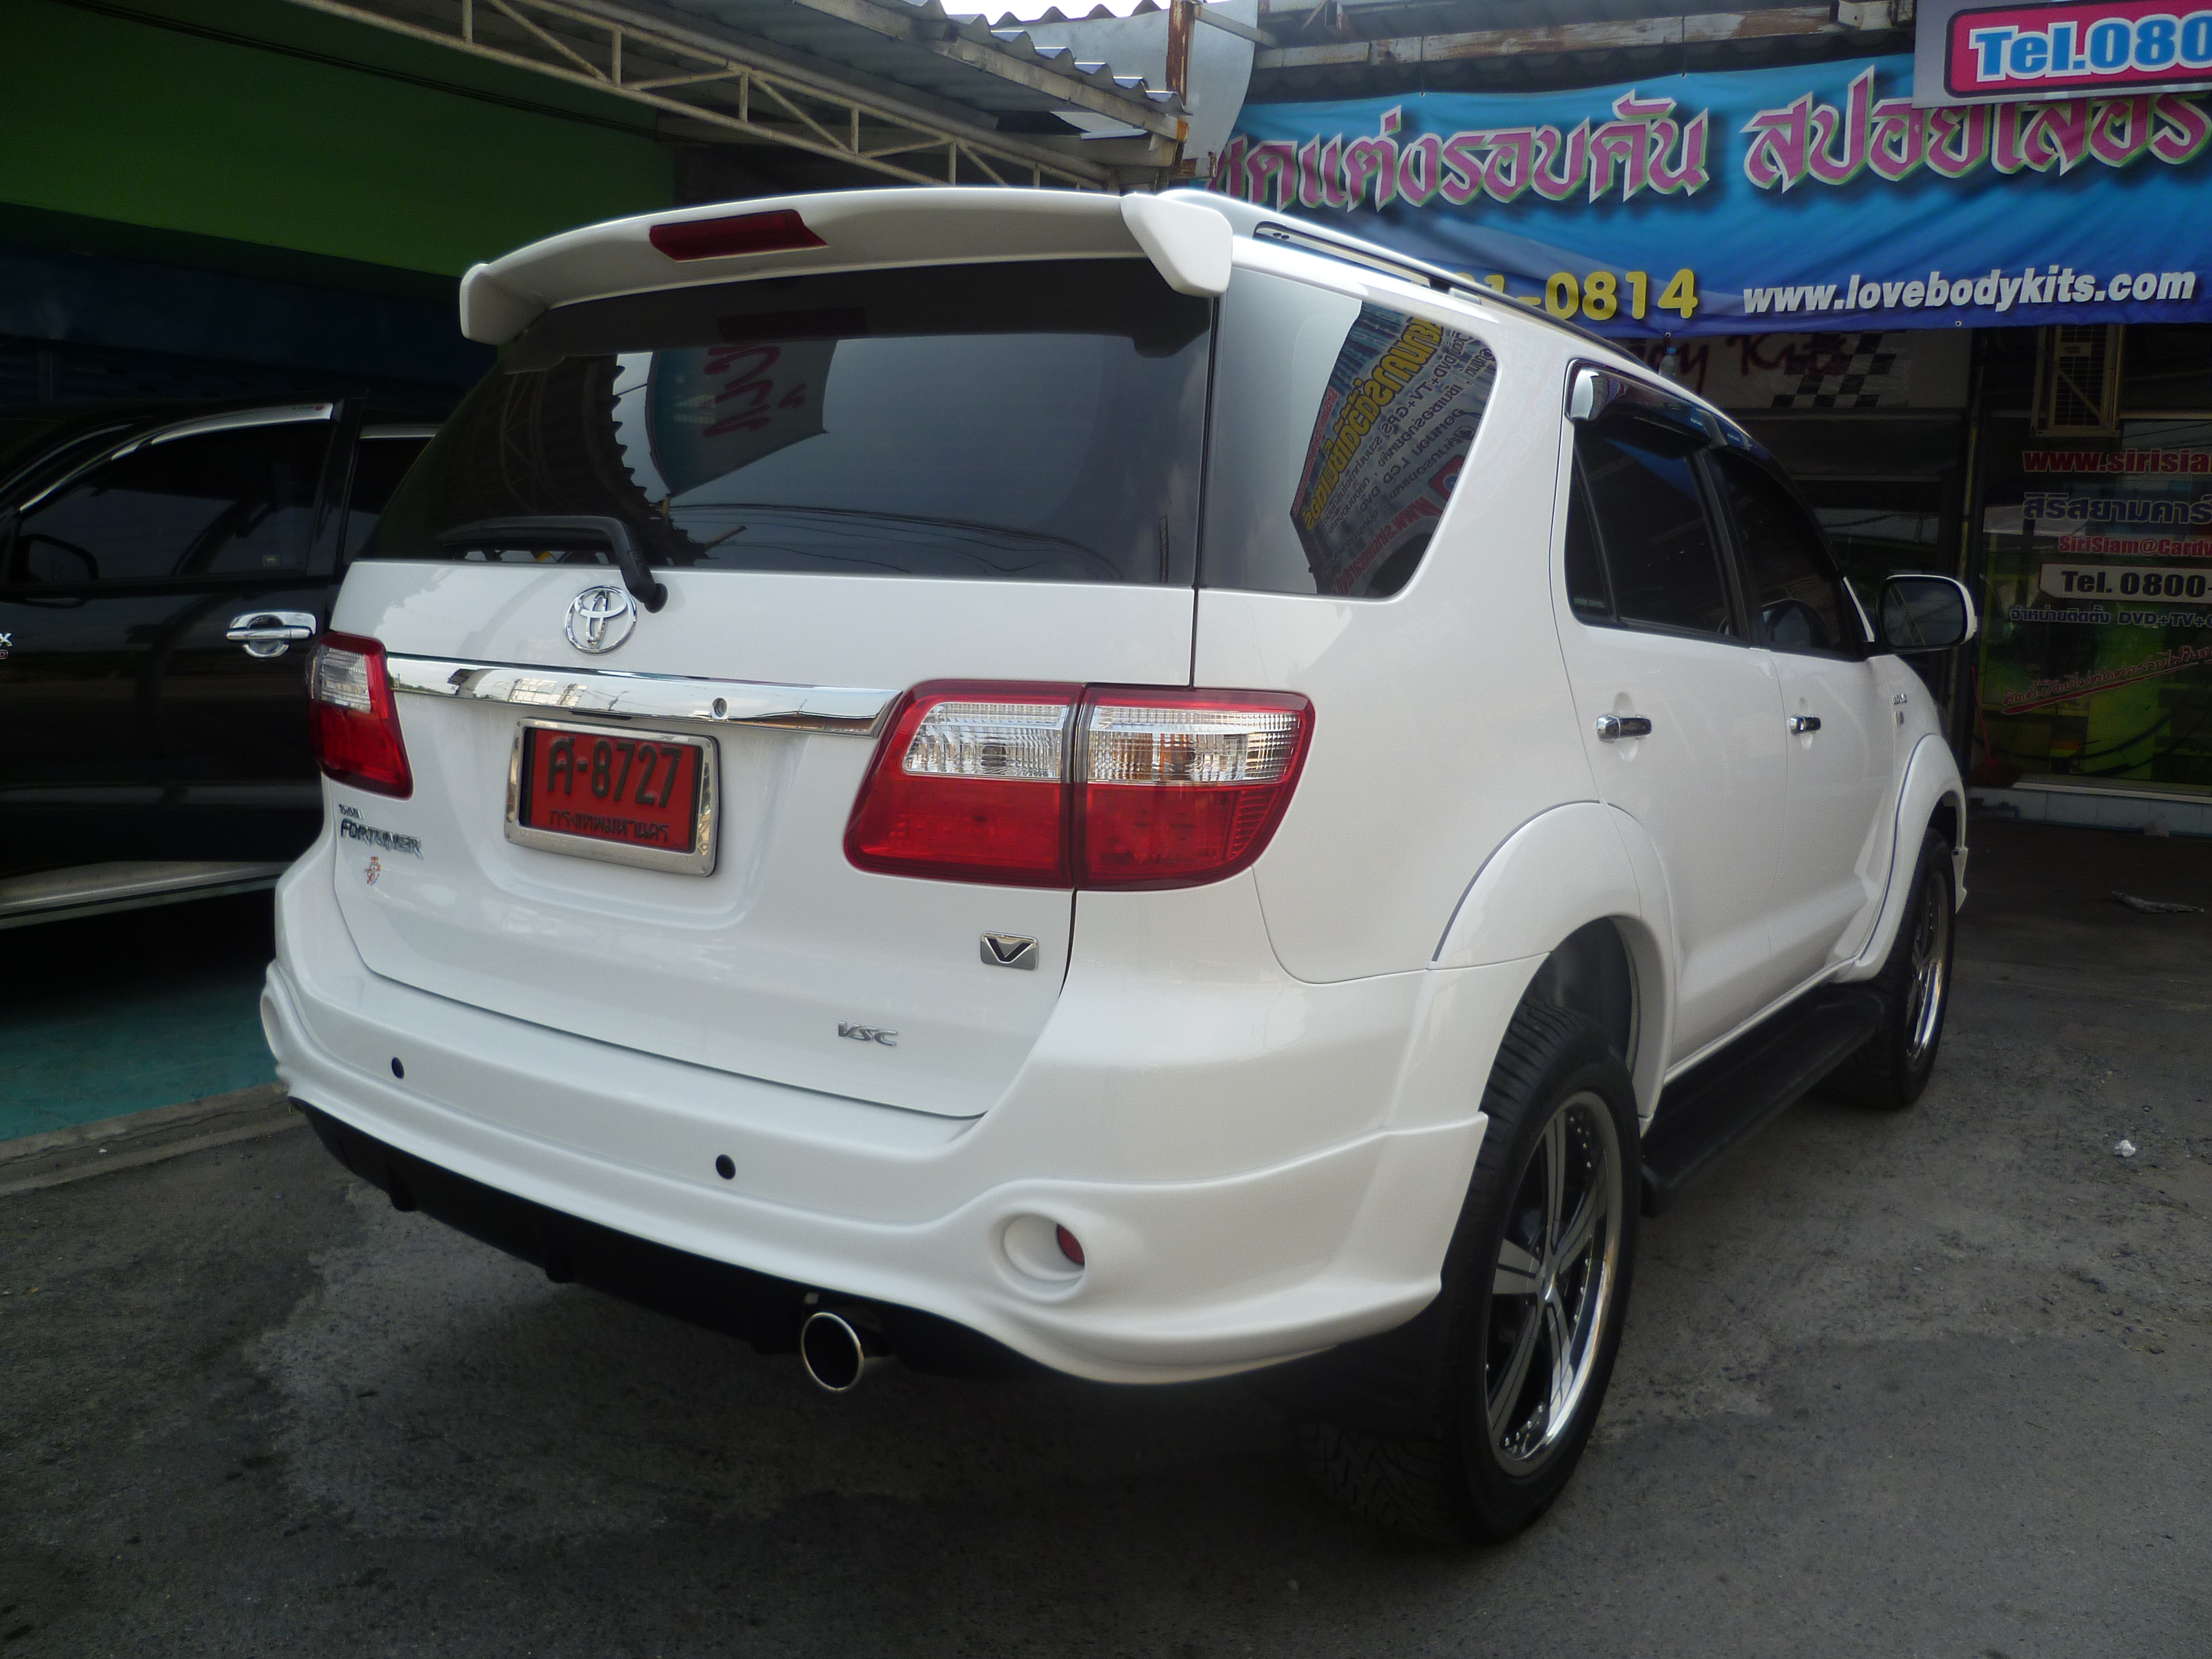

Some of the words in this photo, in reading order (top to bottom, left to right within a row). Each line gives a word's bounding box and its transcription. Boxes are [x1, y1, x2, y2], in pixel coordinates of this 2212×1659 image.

[1743, 265, 2195, 312] www.lovebodykits.com
[2022, 448, 2212, 473] www.sirisia
[2062, 571, 2111, 593] Tel.
[341, 818, 424, 859] FORTUNER
[549, 808, 670, 843] กรุงเทพมหานคร
[838, 1020, 898, 1047] VSC
